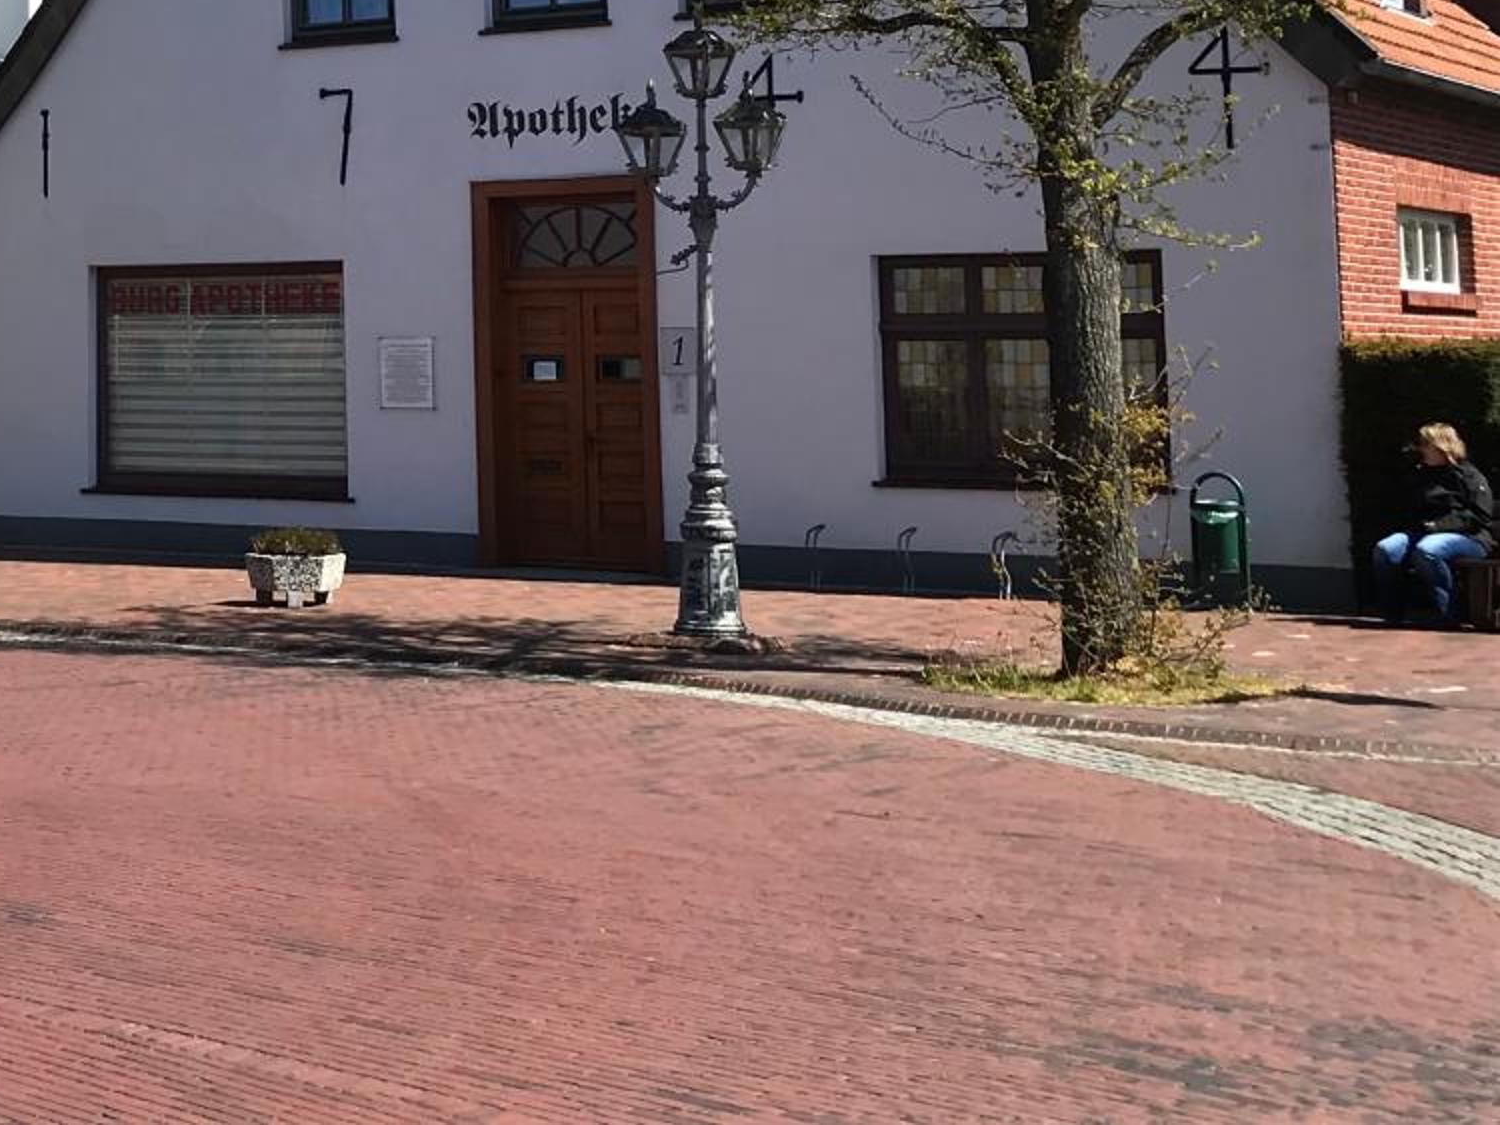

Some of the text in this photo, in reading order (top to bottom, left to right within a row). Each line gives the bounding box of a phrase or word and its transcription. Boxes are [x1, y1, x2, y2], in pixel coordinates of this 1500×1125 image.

[467, 92, 632, 150] Apothek
[110, 281, 340, 315] BURG APOTHEKE
[671, 335, 685, 366] 1
